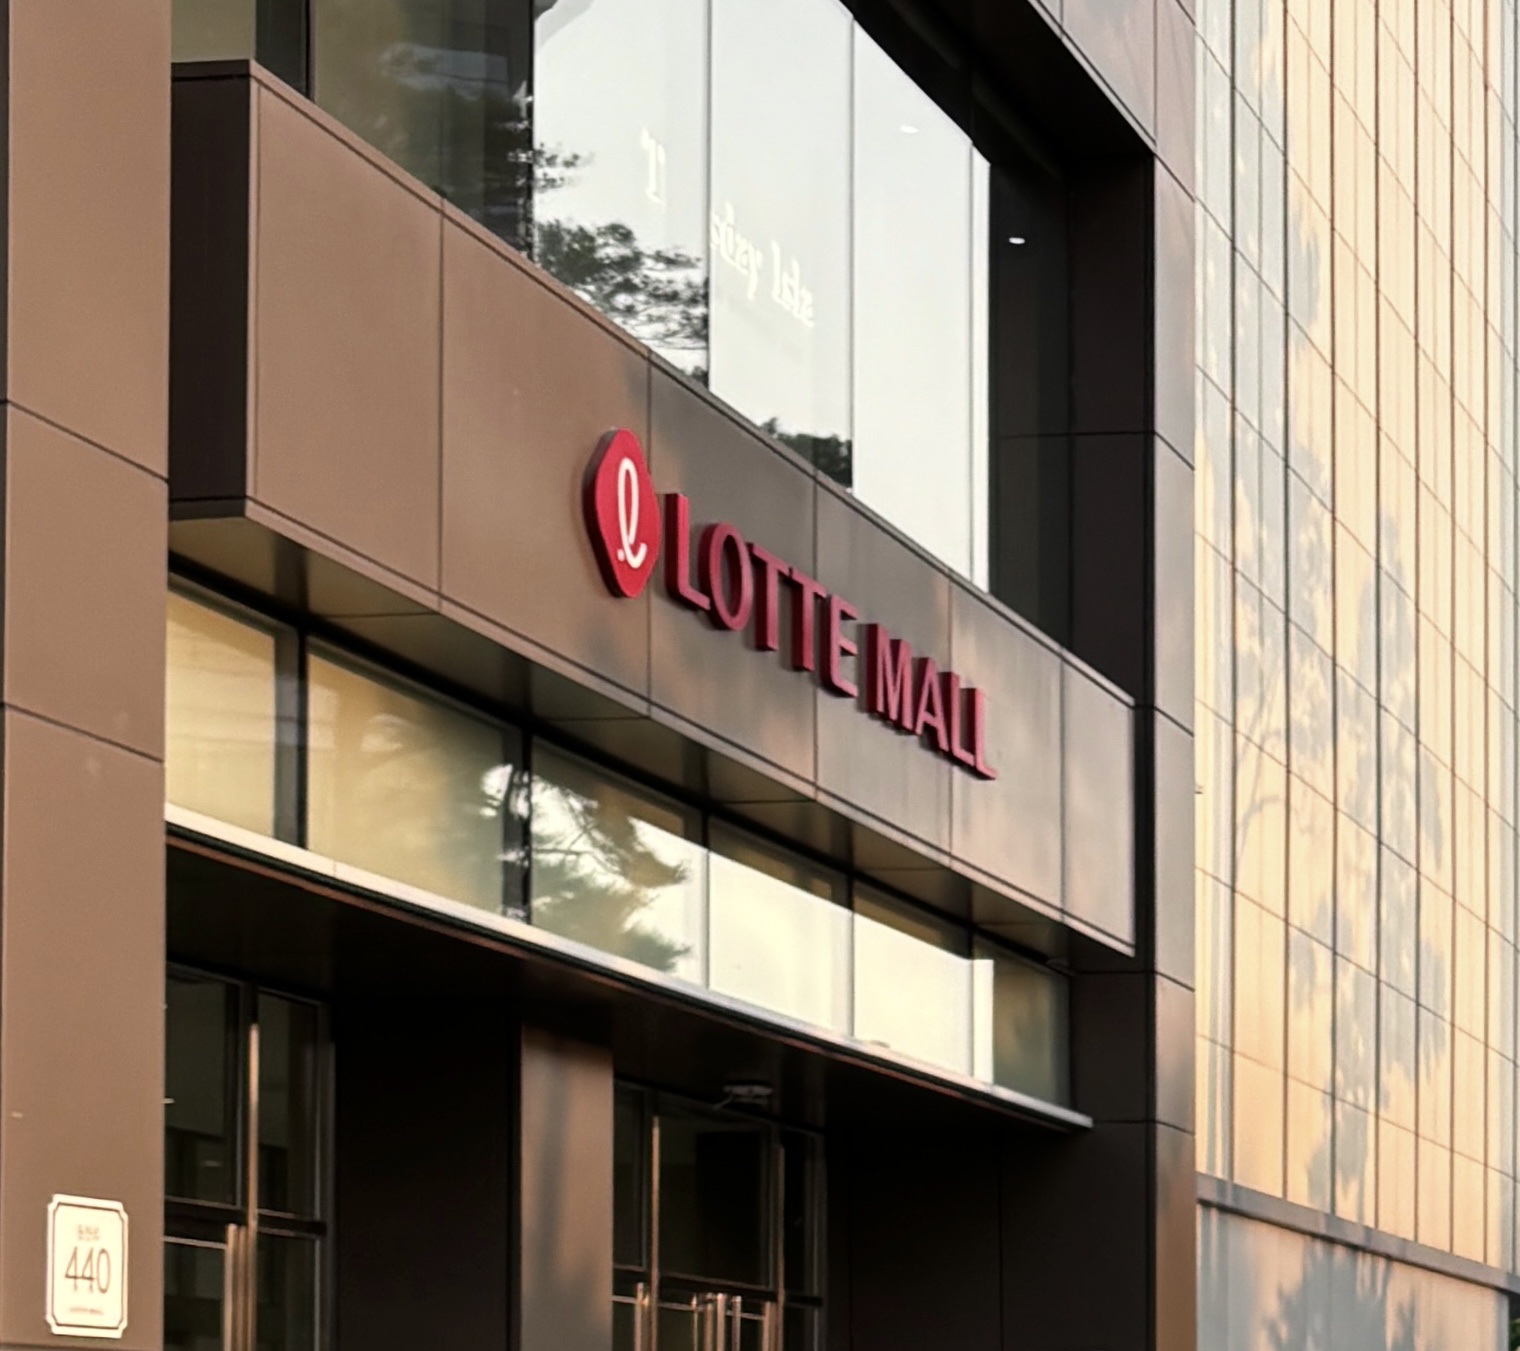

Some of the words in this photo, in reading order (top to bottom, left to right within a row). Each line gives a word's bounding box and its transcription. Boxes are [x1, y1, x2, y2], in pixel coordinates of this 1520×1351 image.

[662, 492, 859, 697] LOTTE
[865, 622, 998, 781] MALL
[64, 1245, 111, 1294] 440
